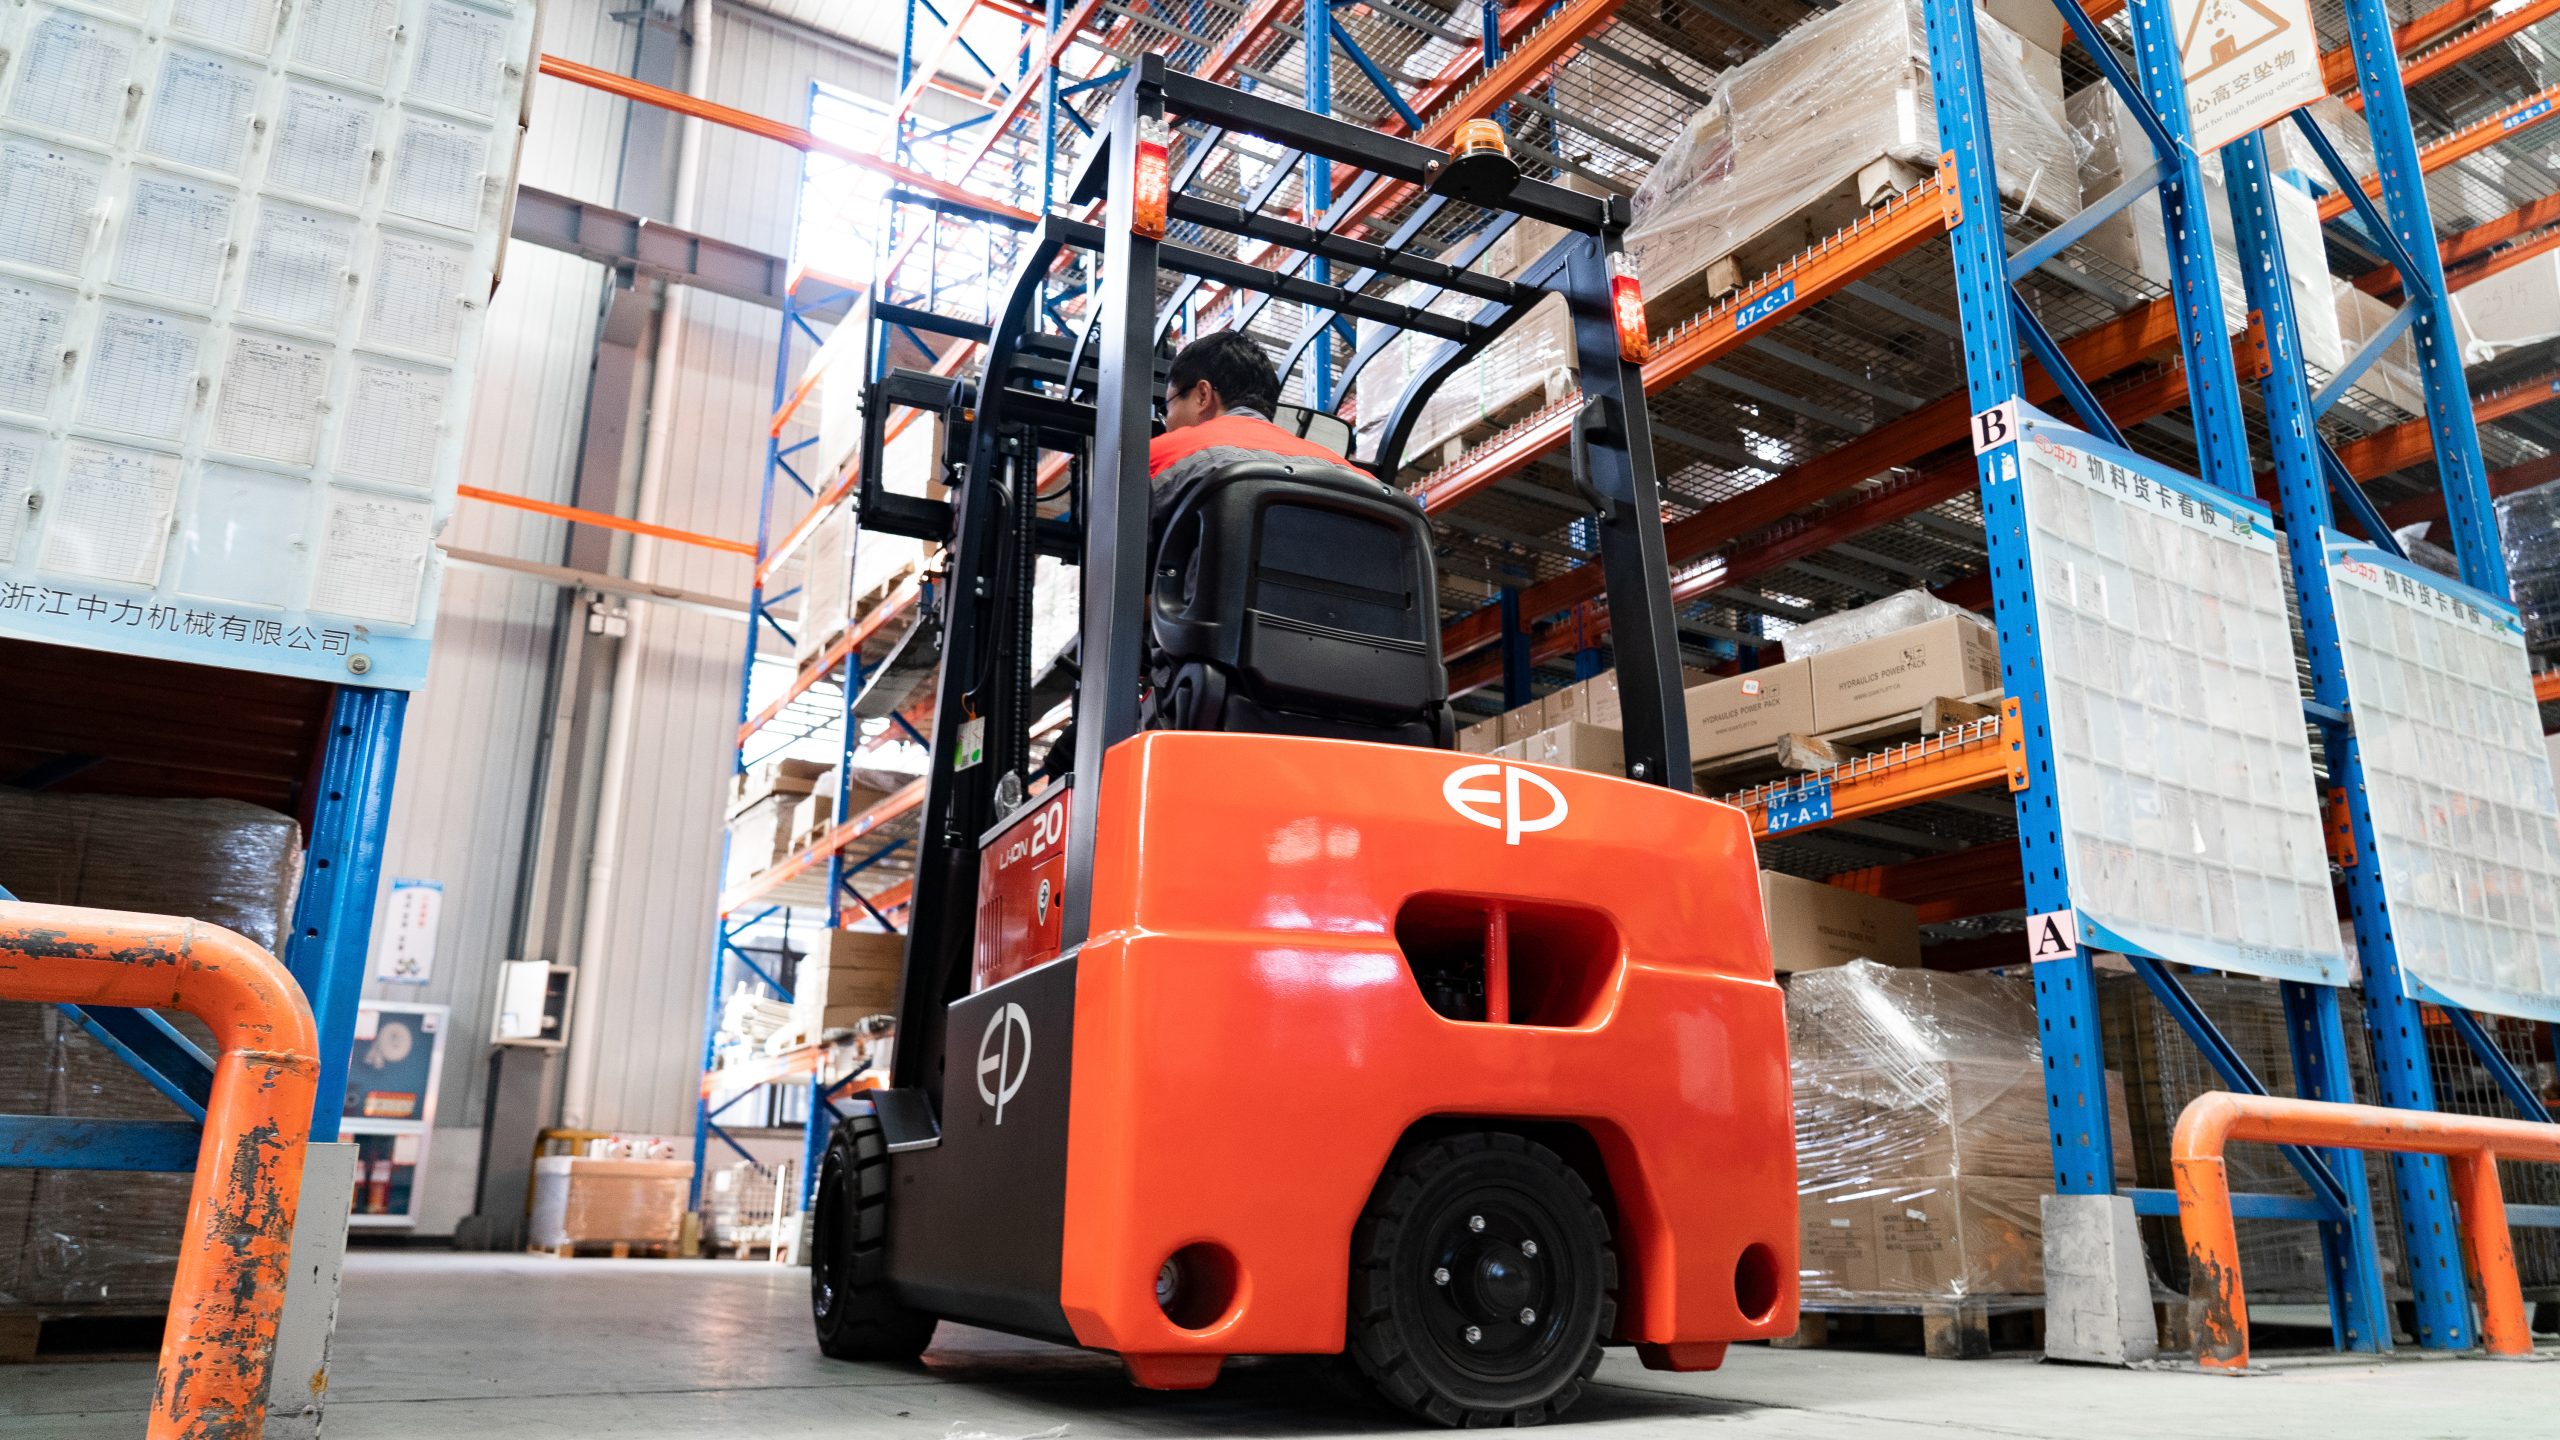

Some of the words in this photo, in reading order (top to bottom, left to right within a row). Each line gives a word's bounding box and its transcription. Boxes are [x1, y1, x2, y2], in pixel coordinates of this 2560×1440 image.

[2210, 115, 2224, 128] for
[2225, 103, 2245, 120] high
[2246, 87, 2275, 106] falling
[2275, 71, 2312, 91] objects
[1737, 286, 1789, 326] 47-C-1
[1977, 409, 2007, 449] B
[2086, 454, 2217, 528] 物料货卡看板
[0, 581, 351, 657] 浙江中力机械有限公司
[2383, 568, 2482, 626] 物料货卡看板
[1839, 671, 1879, 690] HYDRAULICS
[1881, 664, 1906, 679] POWER
[1702, 708, 1739, 725] HYDRAULICS
[1740, 702, 1762, 715] POWER
[1764, 698, 1781, 709] PACK
[1031, 801, 1064, 858] 20
[1442, 763, 1569, 846] EP
[1769, 801, 1829, 831] 47-A-1
[2034, 914, 2073, 956] A
[976, 1001, 1032, 1126] EP
